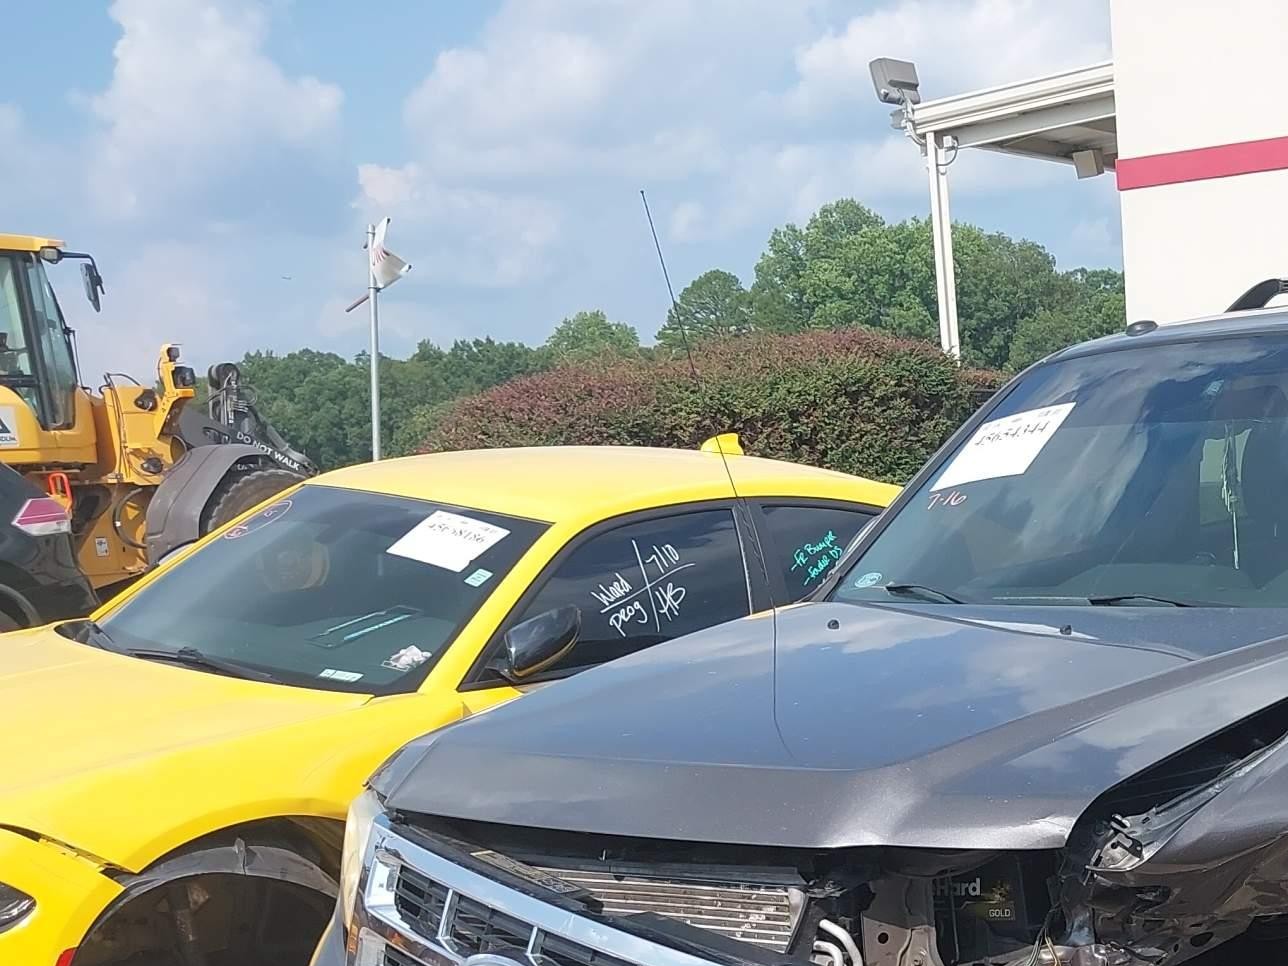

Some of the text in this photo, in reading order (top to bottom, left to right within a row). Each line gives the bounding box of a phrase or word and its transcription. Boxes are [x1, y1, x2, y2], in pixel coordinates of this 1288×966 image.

[236, 431, 252, 444] DO
[252, 440, 273, 456] NOT
[274, 451, 300, 471] WALK
[927, 491, 967, 510] 7-16
[645, 544, 679, 573] 7/10
[988, 908, 1011, 918] GOLD
